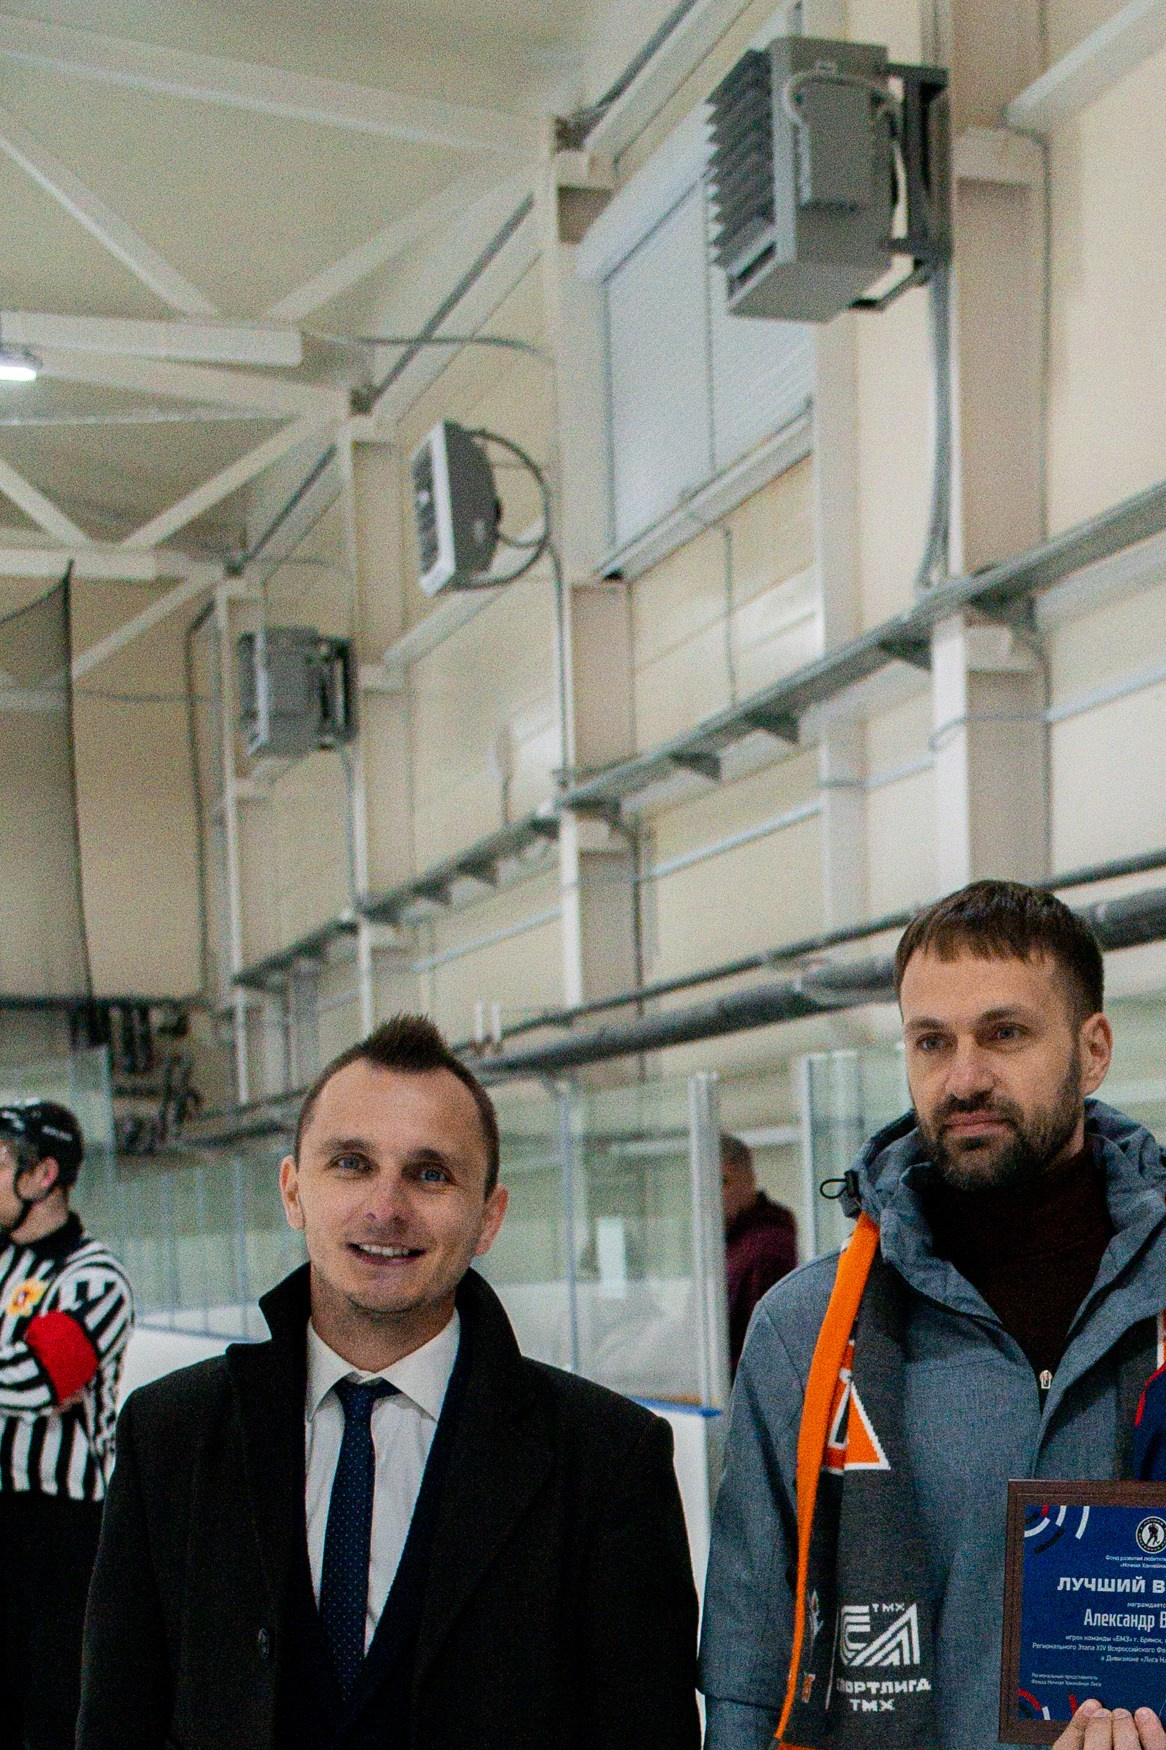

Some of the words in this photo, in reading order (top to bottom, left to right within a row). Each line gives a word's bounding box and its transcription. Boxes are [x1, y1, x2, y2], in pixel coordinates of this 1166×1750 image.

[1057, 1576, 1146, 1593] ЛУЧШИЙ
[1083, 1608, 1155, 1633] Александр
[1032, 1642, 1077, 1651] Регионального
[1107, 1645, 1155, 1653] Всероссийского
[836, 1677, 932, 1695] ОРТЛИГА
